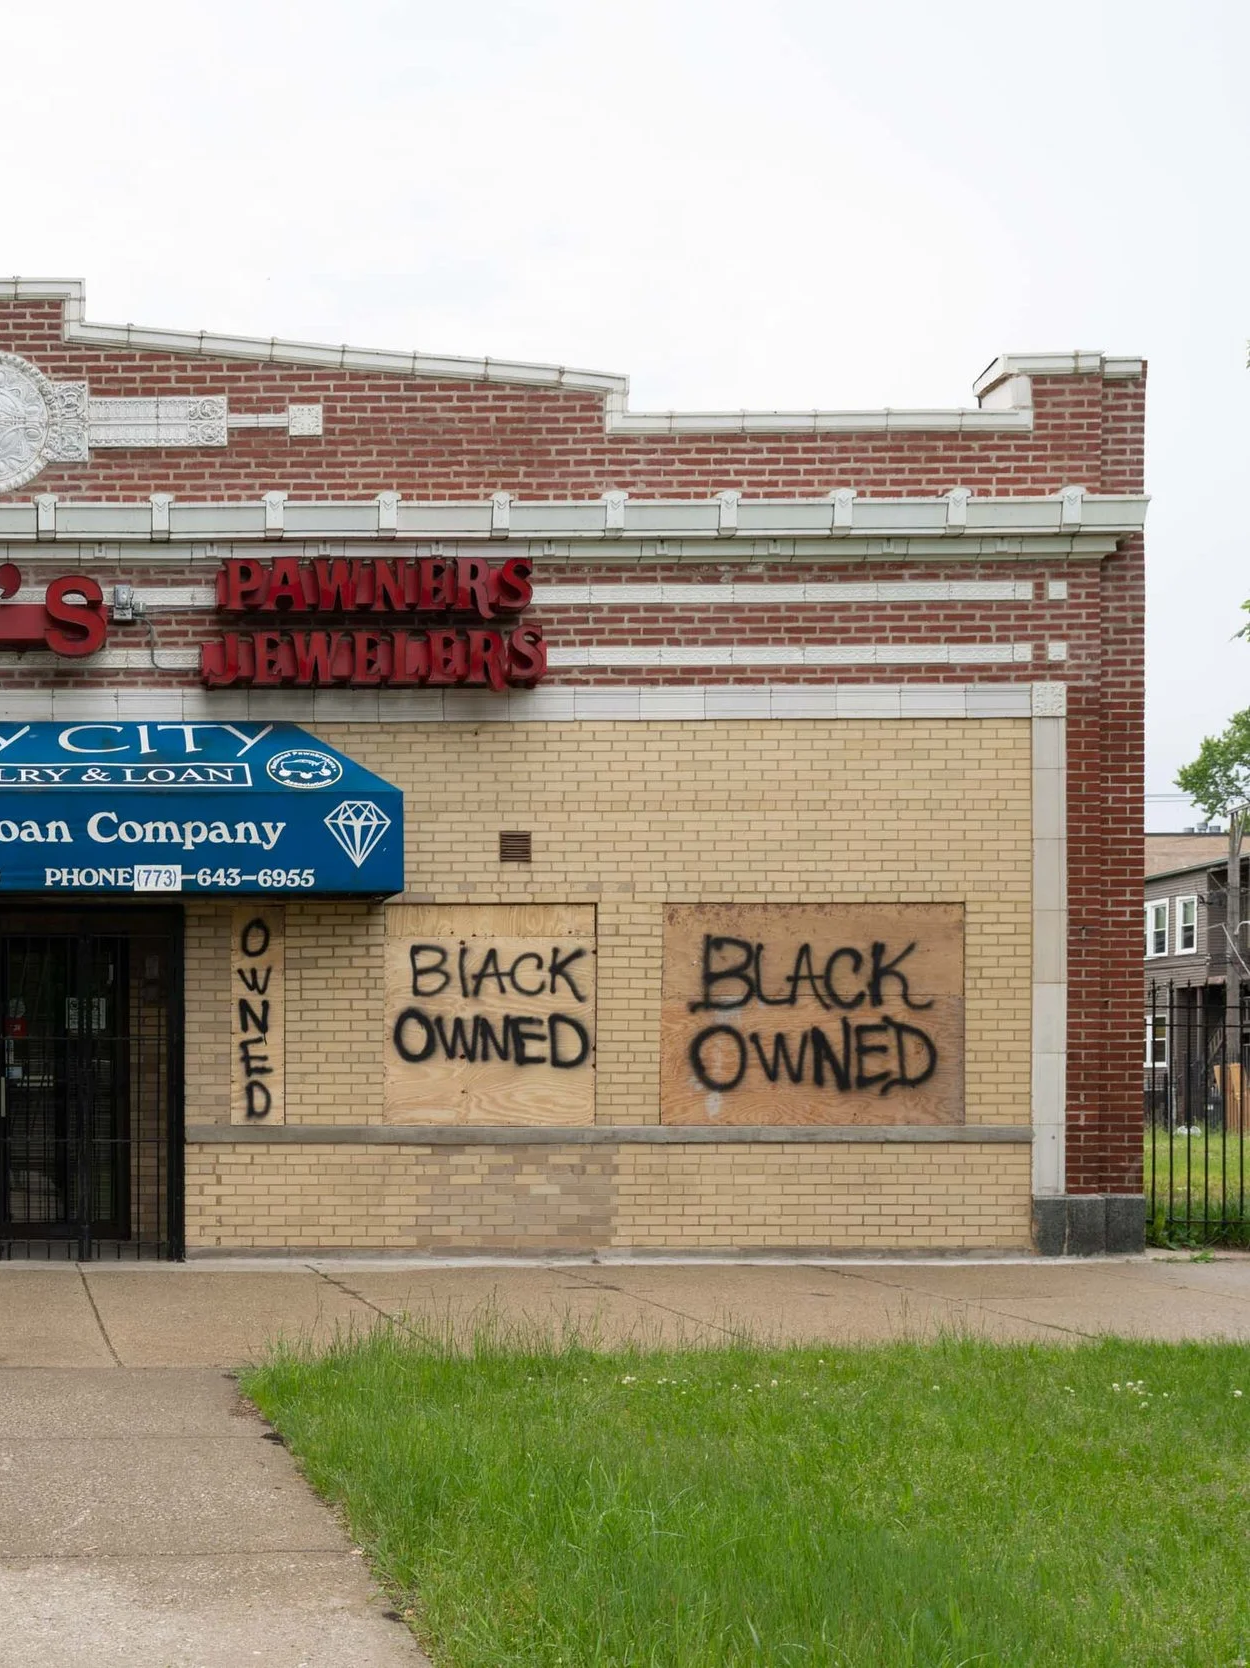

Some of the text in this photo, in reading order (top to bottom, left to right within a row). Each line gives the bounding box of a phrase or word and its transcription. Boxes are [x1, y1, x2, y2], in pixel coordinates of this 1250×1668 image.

[220, 557, 533, 619] PAWNERS
[203, 624, 546, 691] JEWELERS
[58, 724, 274, 757] CITY
[81, 768, 111, 782] &
[122, 768, 233, 782] LOAN
[87, 811, 286, 850] Company
[45, 868, 133, 887] PHONE
[687, 934, 933, 1014] BLACK
[236, 917, 273, 1119] OWNED
[393, 1006, 590, 1068] OWNED
[689, 1016, 938, 1096] OWNED
